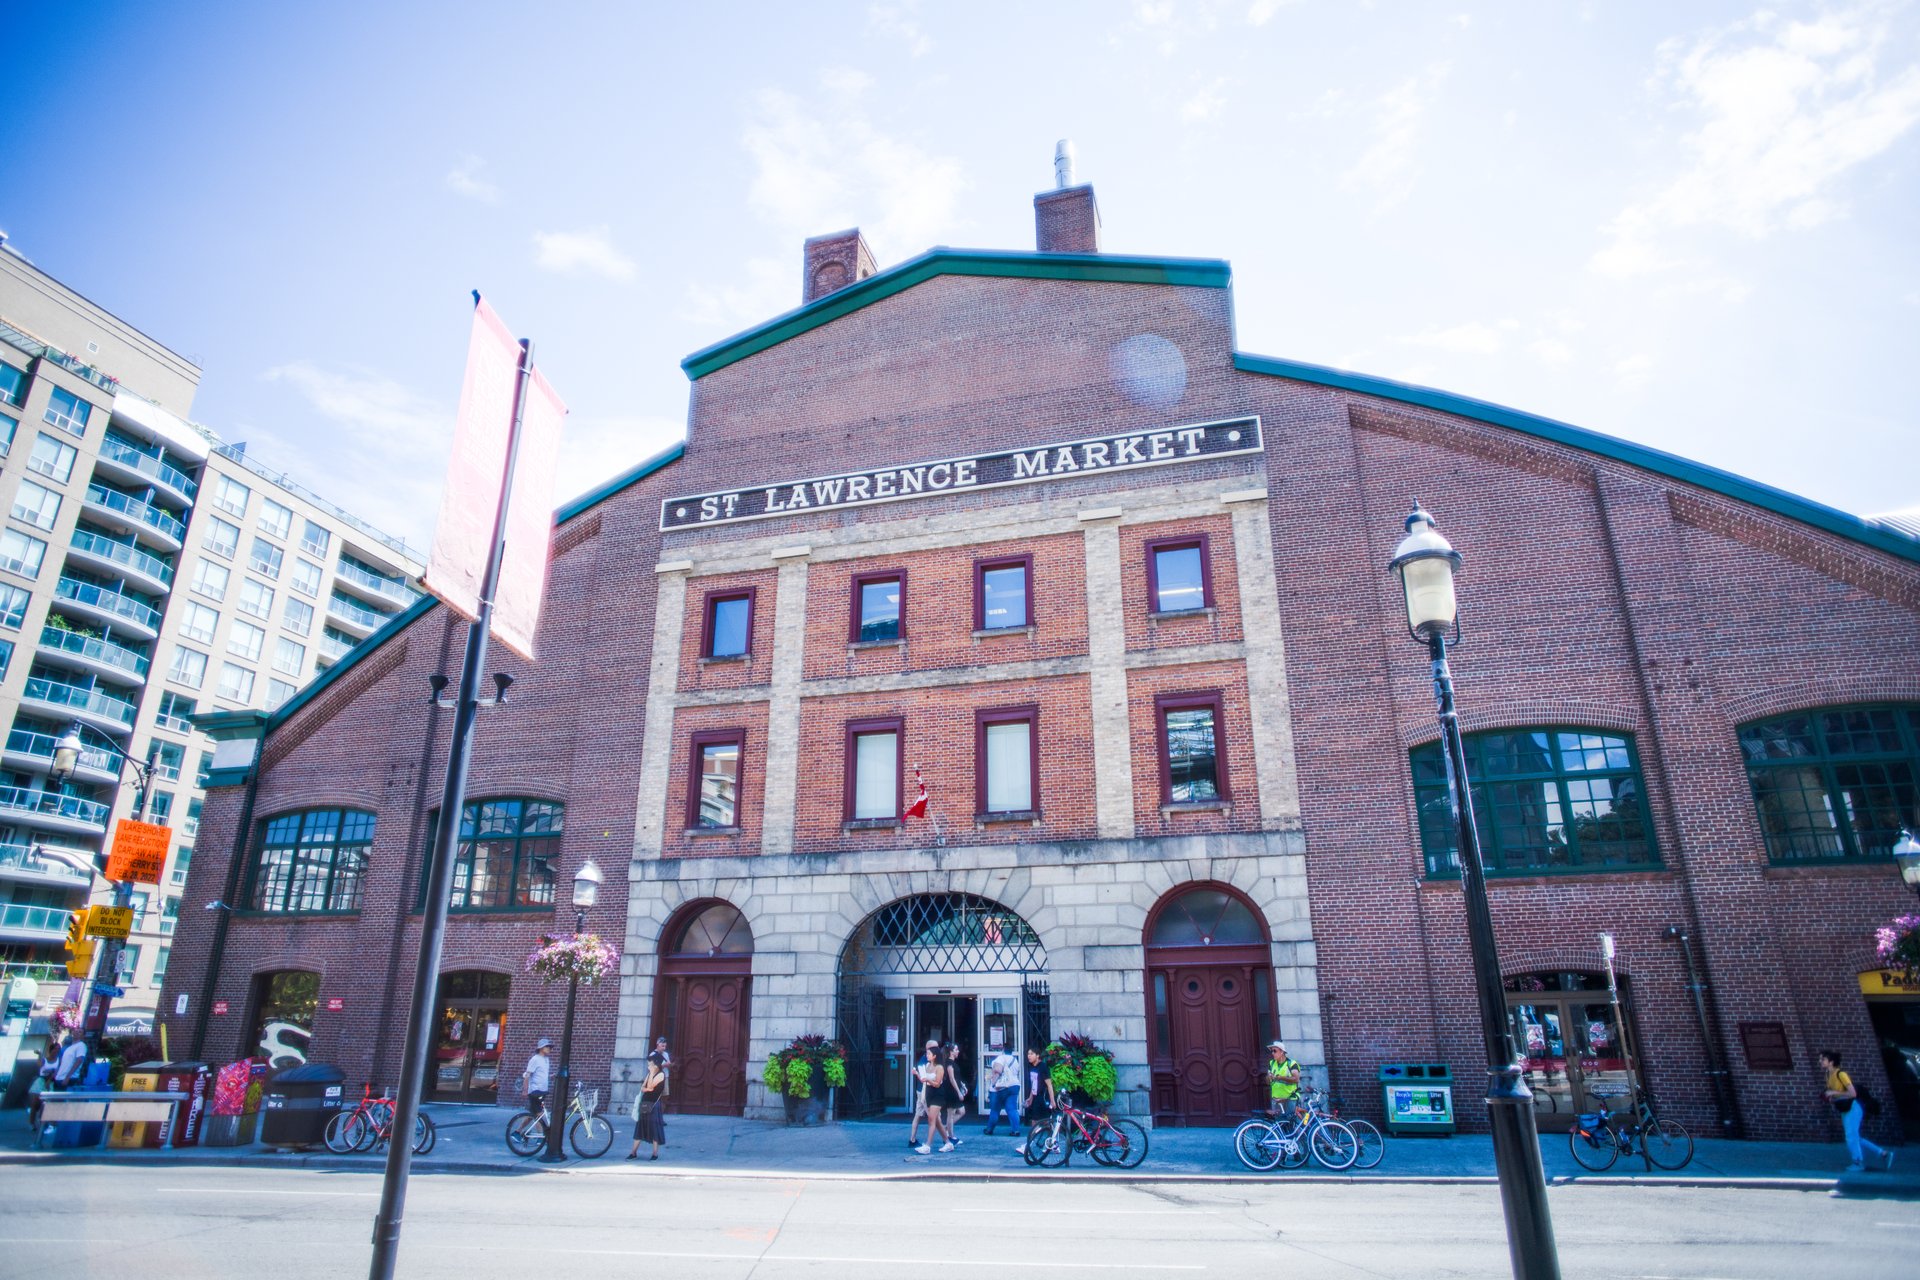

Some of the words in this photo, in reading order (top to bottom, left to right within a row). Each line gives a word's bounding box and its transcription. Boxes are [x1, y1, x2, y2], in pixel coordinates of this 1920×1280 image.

[763, 458, 979, 513] LAWRENCE
[1012, 426, 1207, 480] MARKET
[112, 855, 123, 866] TO
[123, 857, 152, 870] CHERRY
[100, 907, 110, 916] DO
[112, 908, 126, 917] NOT
[99, 917, 122, 926] BLOCK
[88, 926, 129, 936] INTERSECTION
[106, 1025, 136, 1033] MARKET
